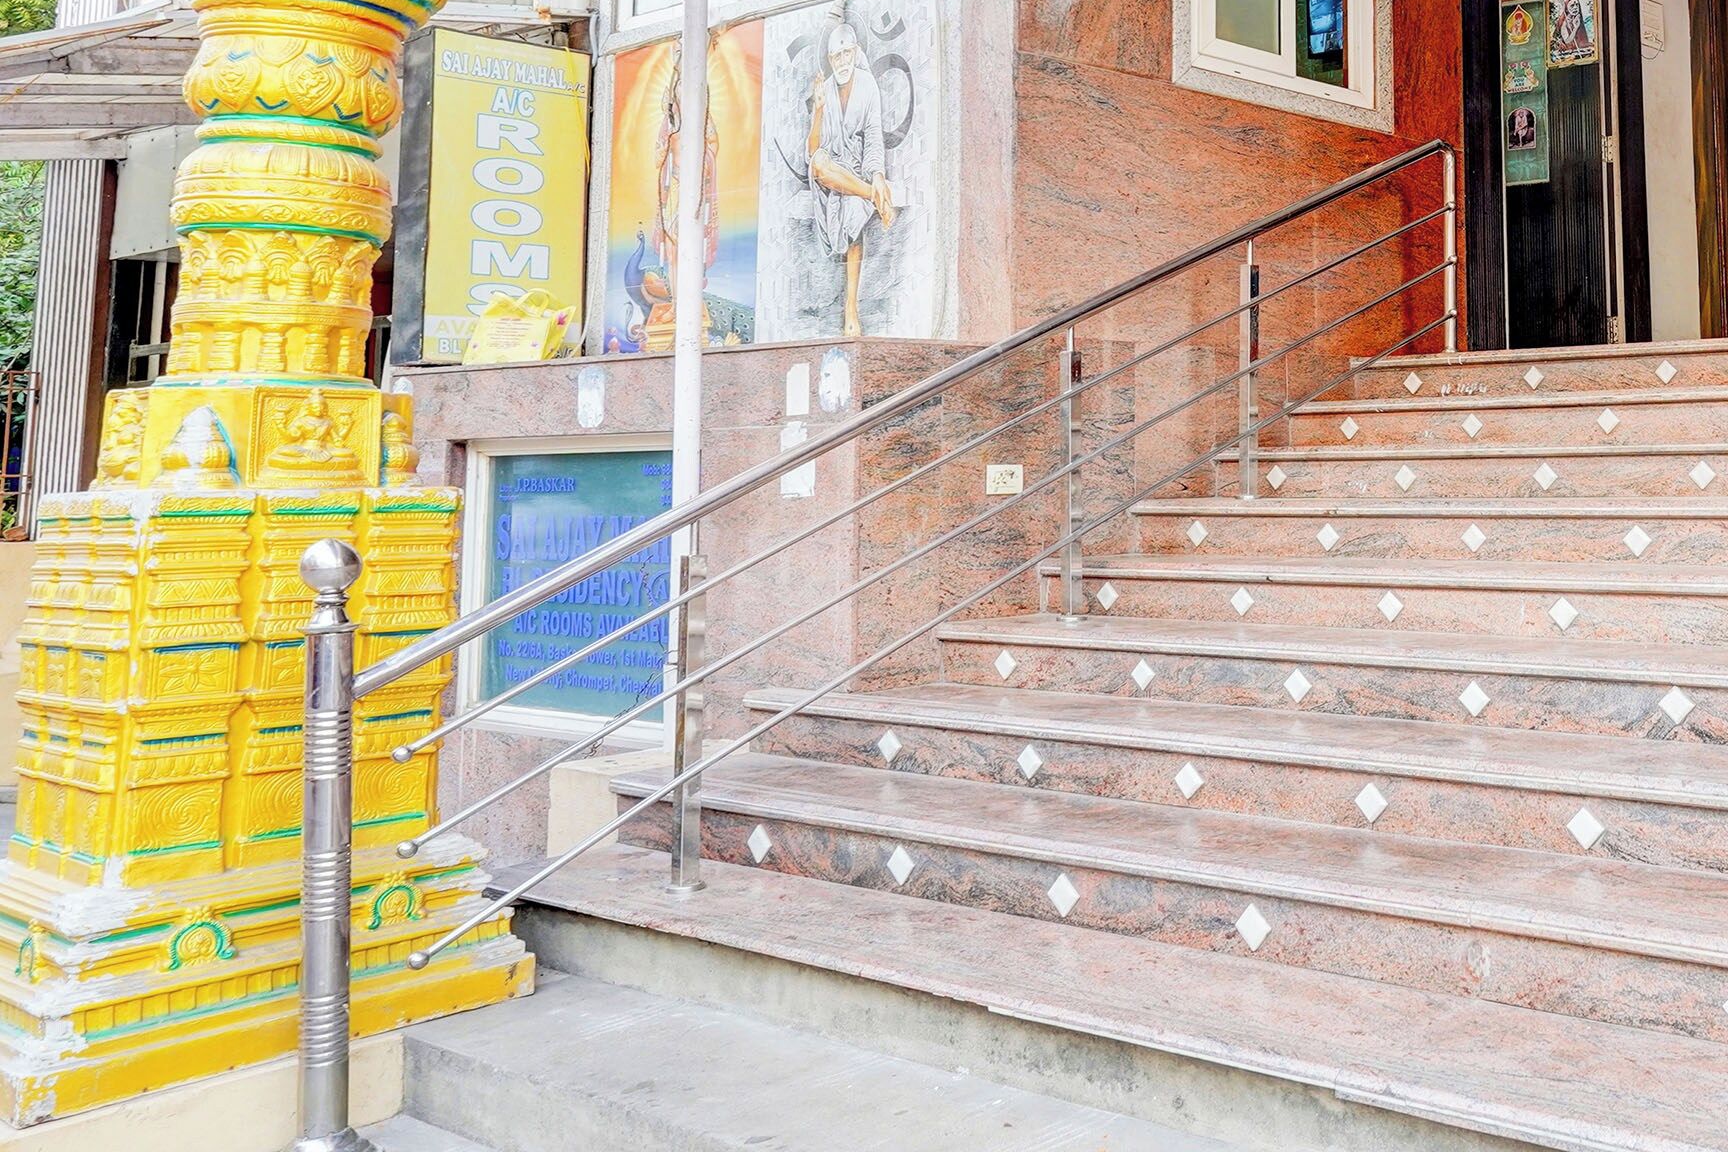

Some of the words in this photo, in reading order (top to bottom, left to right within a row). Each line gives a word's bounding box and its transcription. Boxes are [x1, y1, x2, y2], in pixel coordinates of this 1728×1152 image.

[441, 49, 469, 75] SAI
[472, 55, 512, 81] AJAY
[514, 60, 566, 90] MAHAL
[491, 87, 535, 118] A/C
[515, 477, 576, 493] J.P.BASKAR
[497, 514, 537, 561] SAI
[542, 515, 605, 562] AJAY
[514, 609, 536, 635] A/C
[541, 610, 594, 638] ROOMS
[497, 640, 513, 657] No.
[621, 649, 636, 666] 1st
[506, 665, 527, 681] New
[566, 669, 617, 693] Chrompet,
